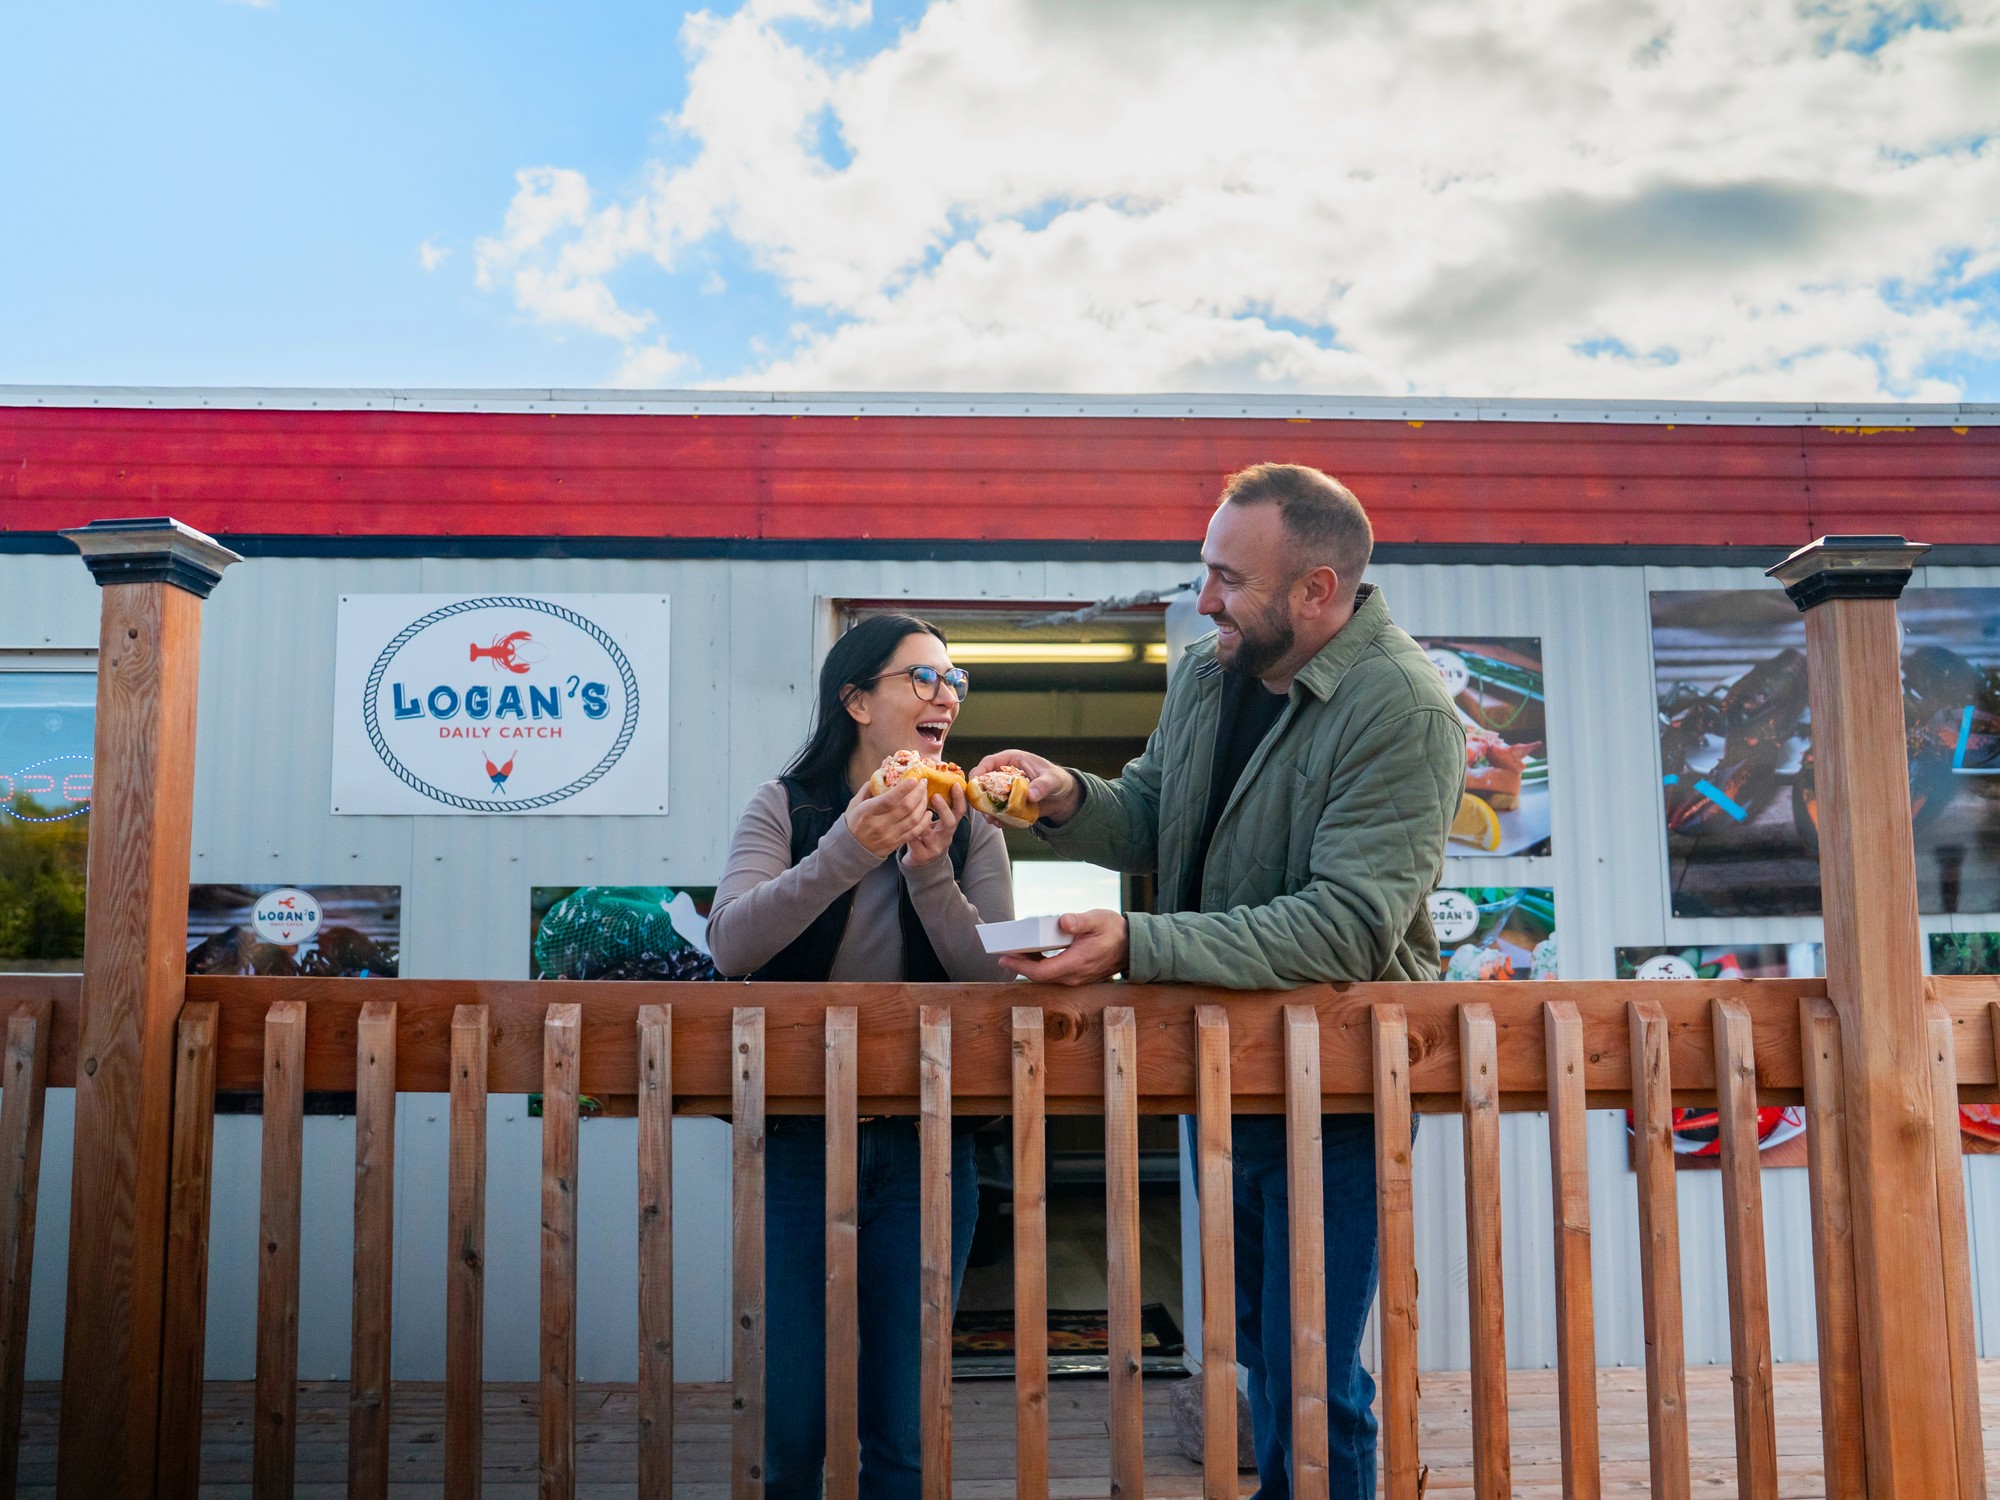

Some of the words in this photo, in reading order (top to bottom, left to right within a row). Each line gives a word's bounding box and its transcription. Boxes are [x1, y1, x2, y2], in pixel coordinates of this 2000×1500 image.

[392, 674, 610, 720] LOGAN'S
[439, 726, 491, 738] DAILY
[499, 726, 563, 738] CATCH
[0, 774, 93, 801] OPE
[258, 908, 315, 921] LOGAN'S
[1431, 909, 1473, 920] OGAN'S
